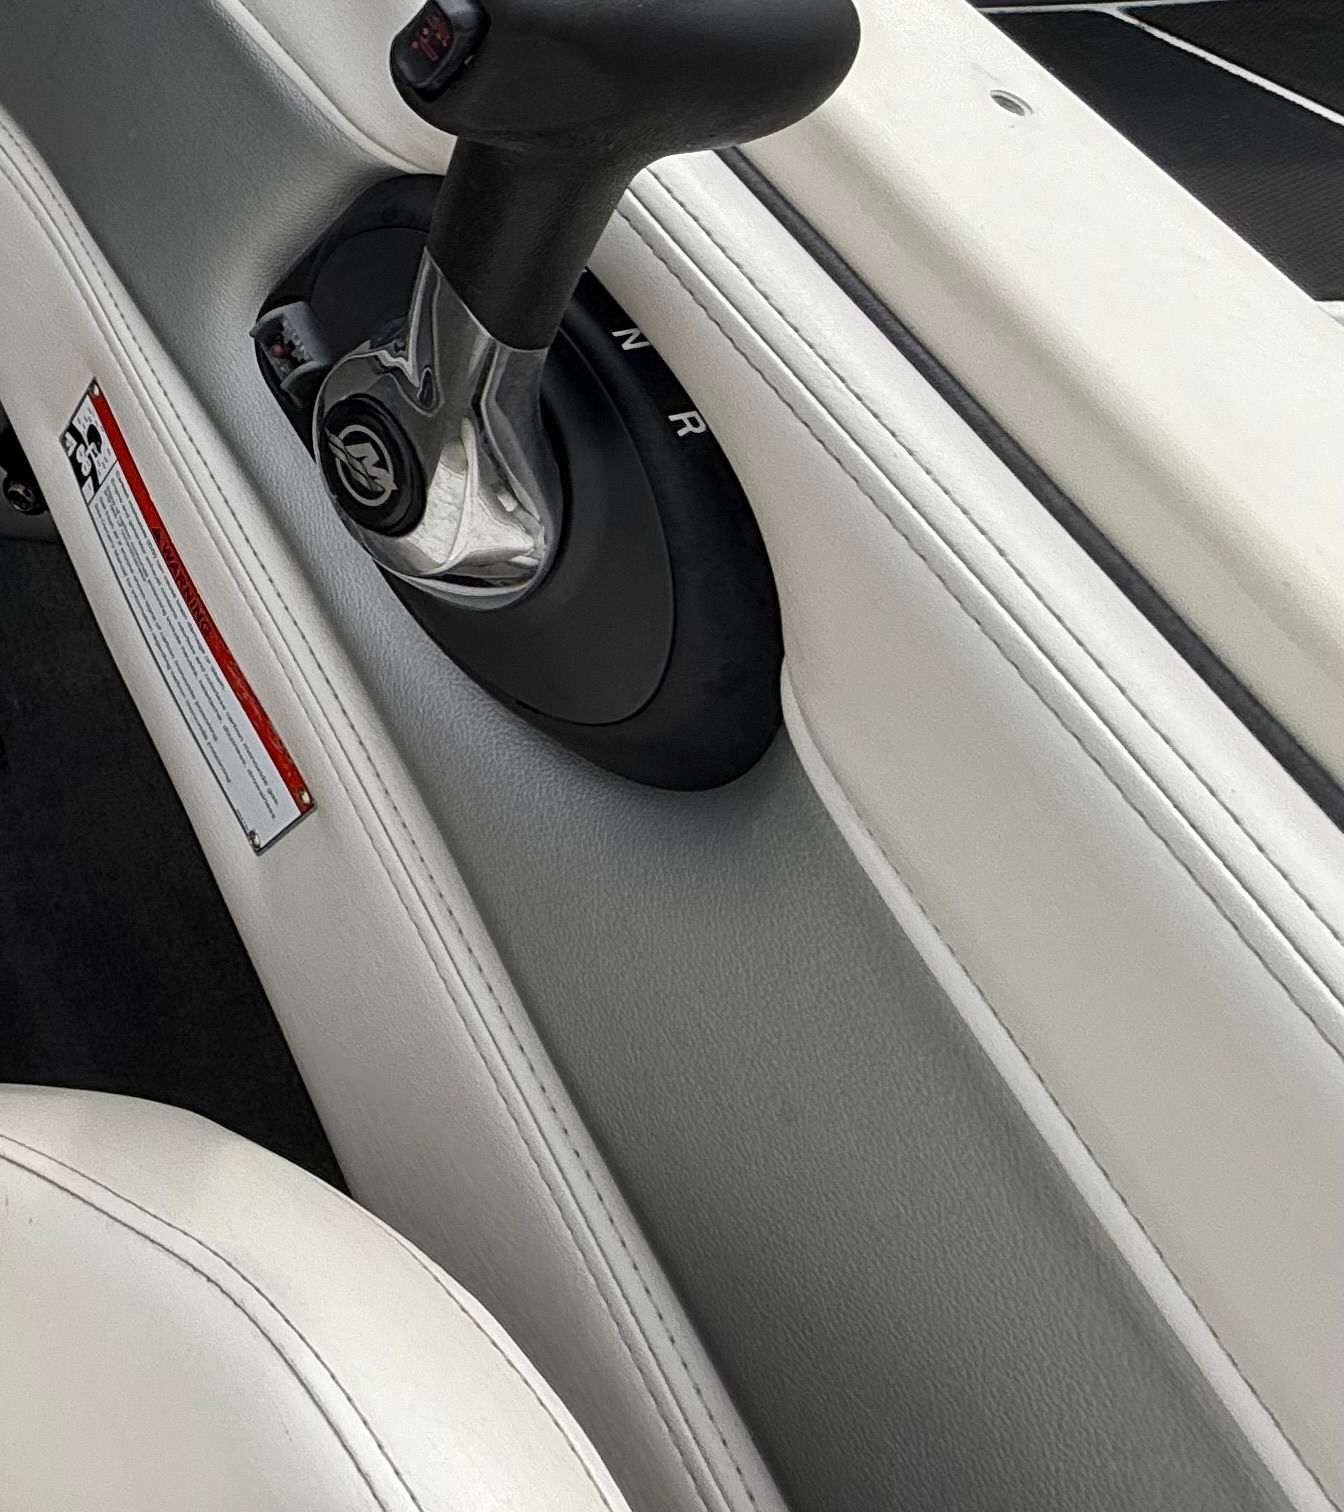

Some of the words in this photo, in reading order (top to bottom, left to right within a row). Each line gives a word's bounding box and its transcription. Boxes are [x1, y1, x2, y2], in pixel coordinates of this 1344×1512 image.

[612, 327, 651, 351] N
[668, 410, 707, 437] R
[159, 537, 211, 637] WARNING
